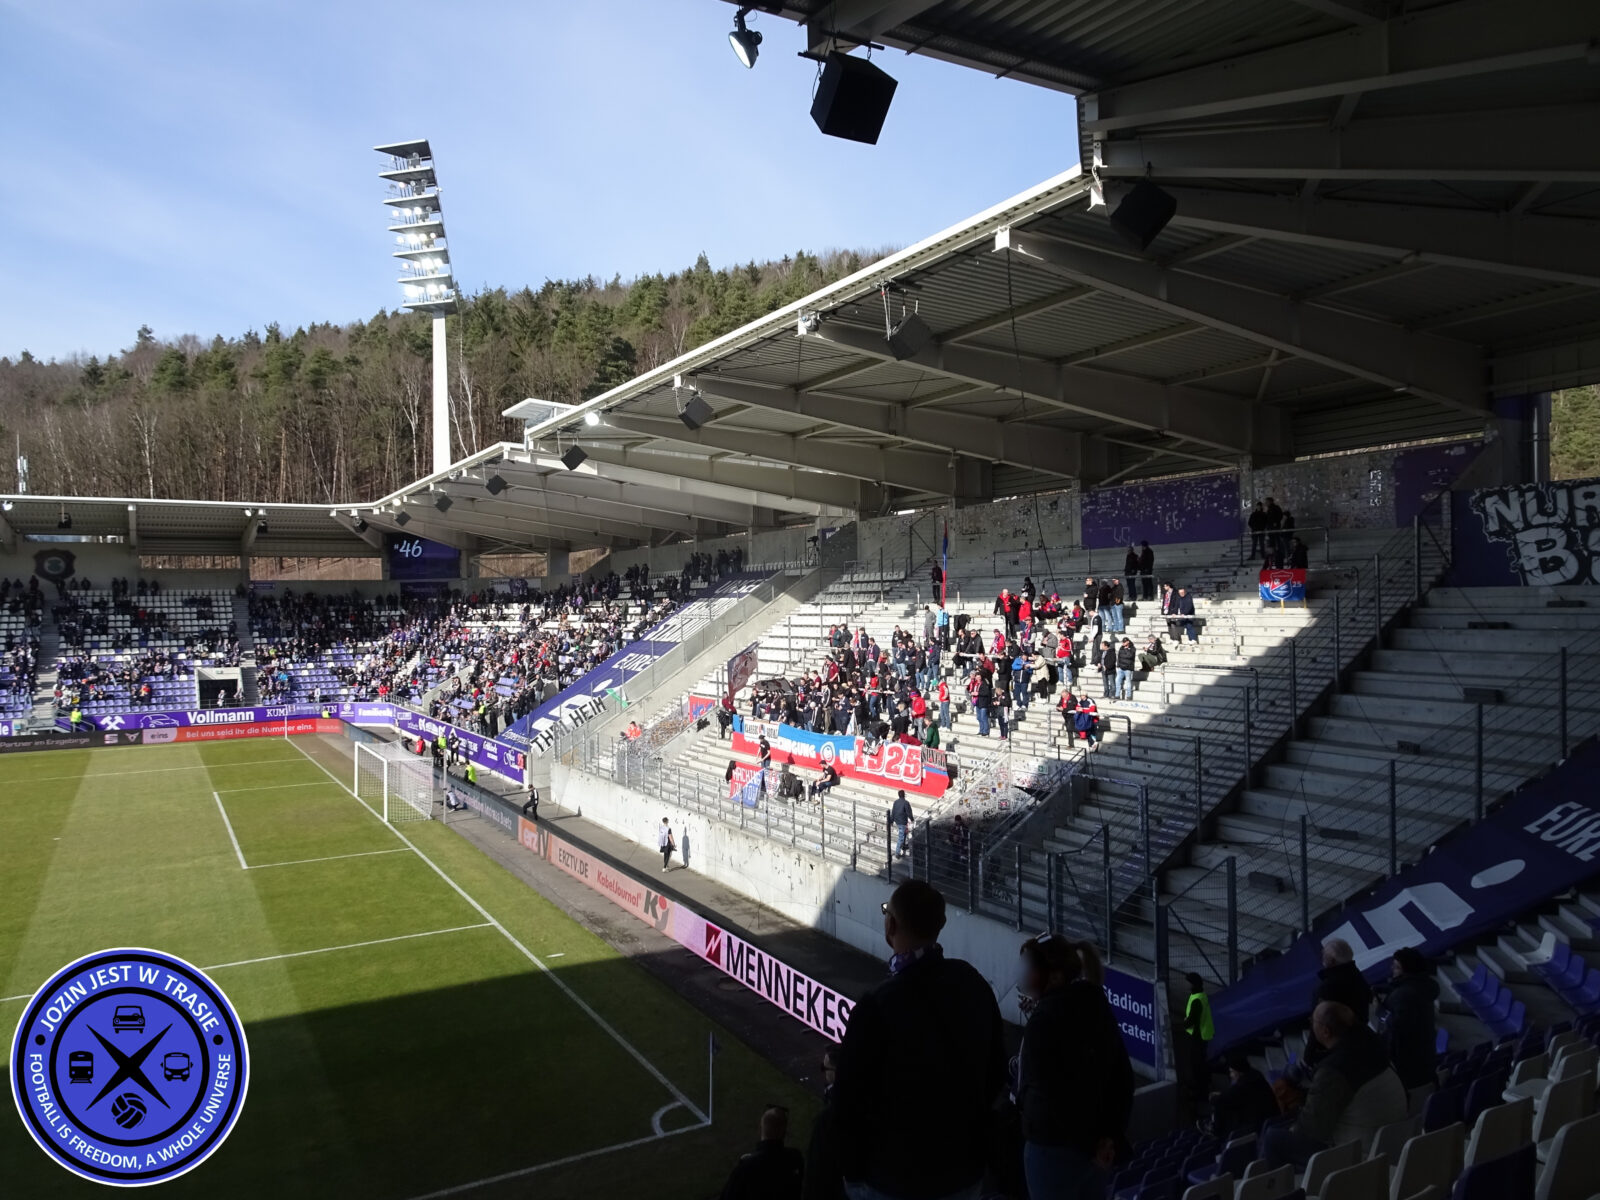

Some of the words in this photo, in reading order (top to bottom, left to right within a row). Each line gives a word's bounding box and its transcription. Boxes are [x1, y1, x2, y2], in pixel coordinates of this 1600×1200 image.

[1516, 527, 1600, 586] B
[187, 710, 254, 724] Vollmann
[150, 732, 168, 740] eins
[217, 728, 233, 736] seid
[262, 725, 295, 733] Nummer
[46, 737, 90, 746] Erzgebirge
[558, 847, 589, 878] ERZTV.DE
[726, 935, 851, 1040] MENNEKES
